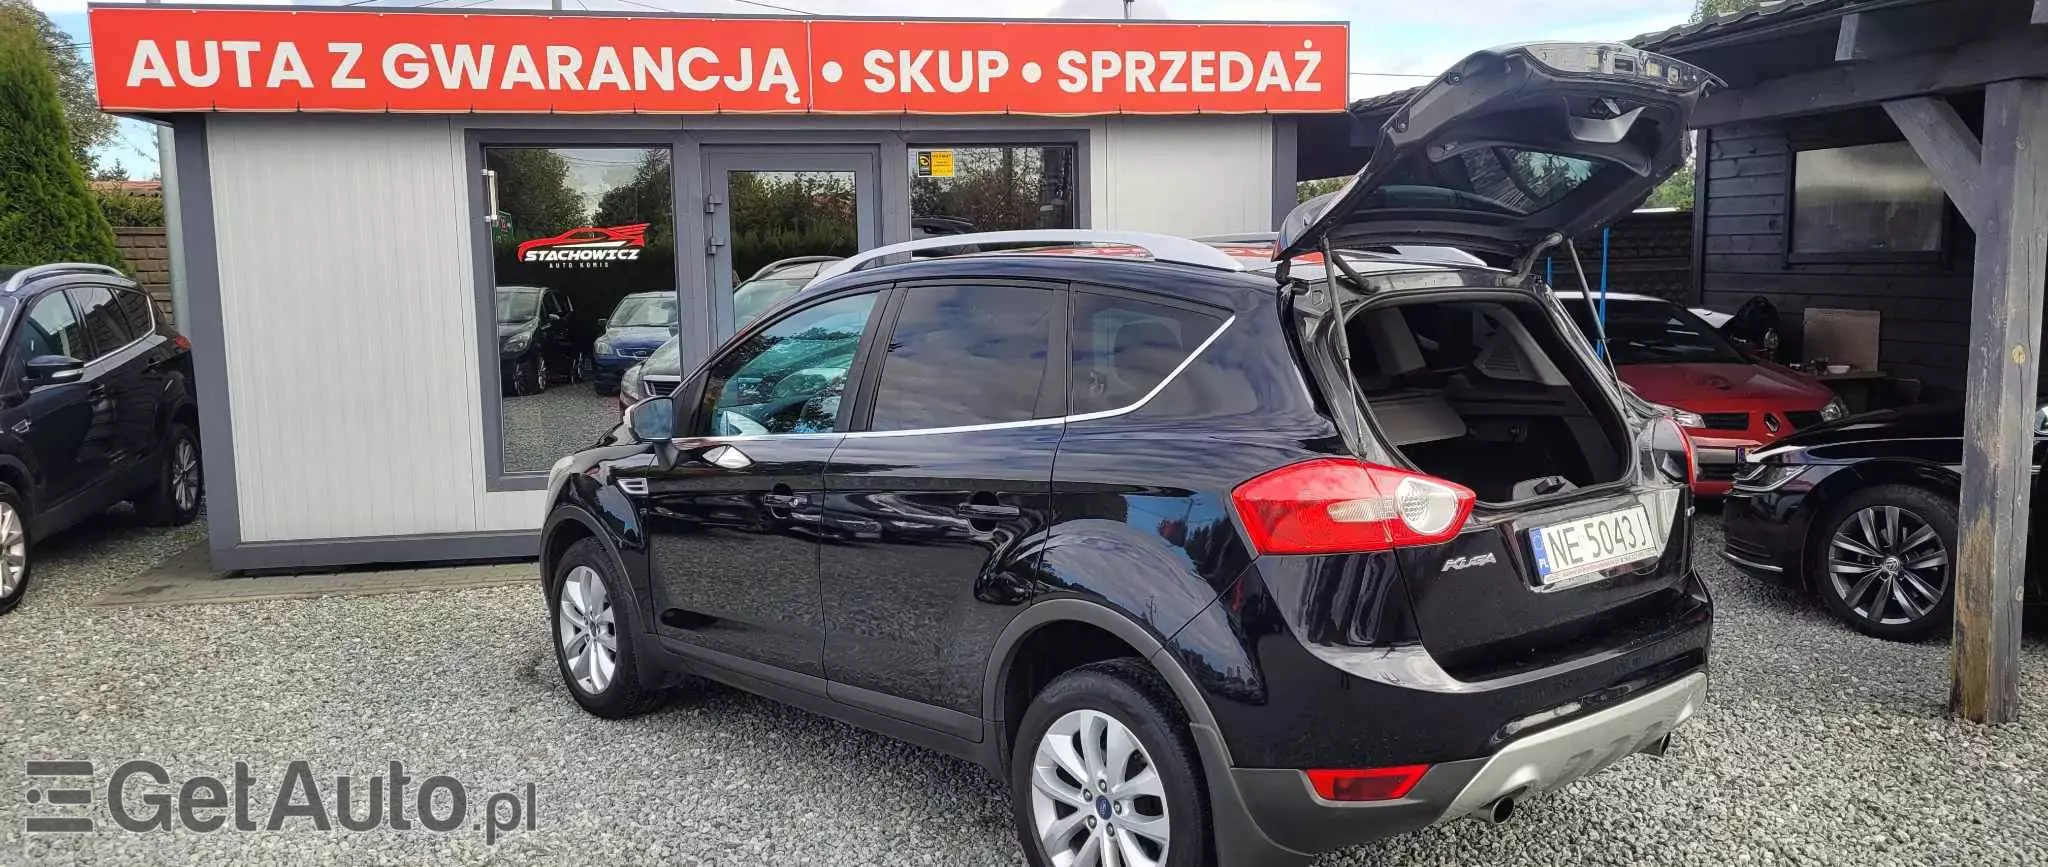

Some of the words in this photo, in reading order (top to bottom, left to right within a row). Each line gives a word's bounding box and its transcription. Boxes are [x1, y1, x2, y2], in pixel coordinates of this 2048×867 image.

[125, 38, 313, 89] AUTA
[328, 43, 365, 90] Z
[381, 43, 801, 105] GWARANCJĄ
[862, 48, 1009, 94] SKUP
[1056, 39, 1322, 93] SPRZEDAŻ
[523, 248, 641, 262] STACHOWICZ
[1547, 526, 1584, 569] NE
[1584, 511, 1648, 559] 5043J
